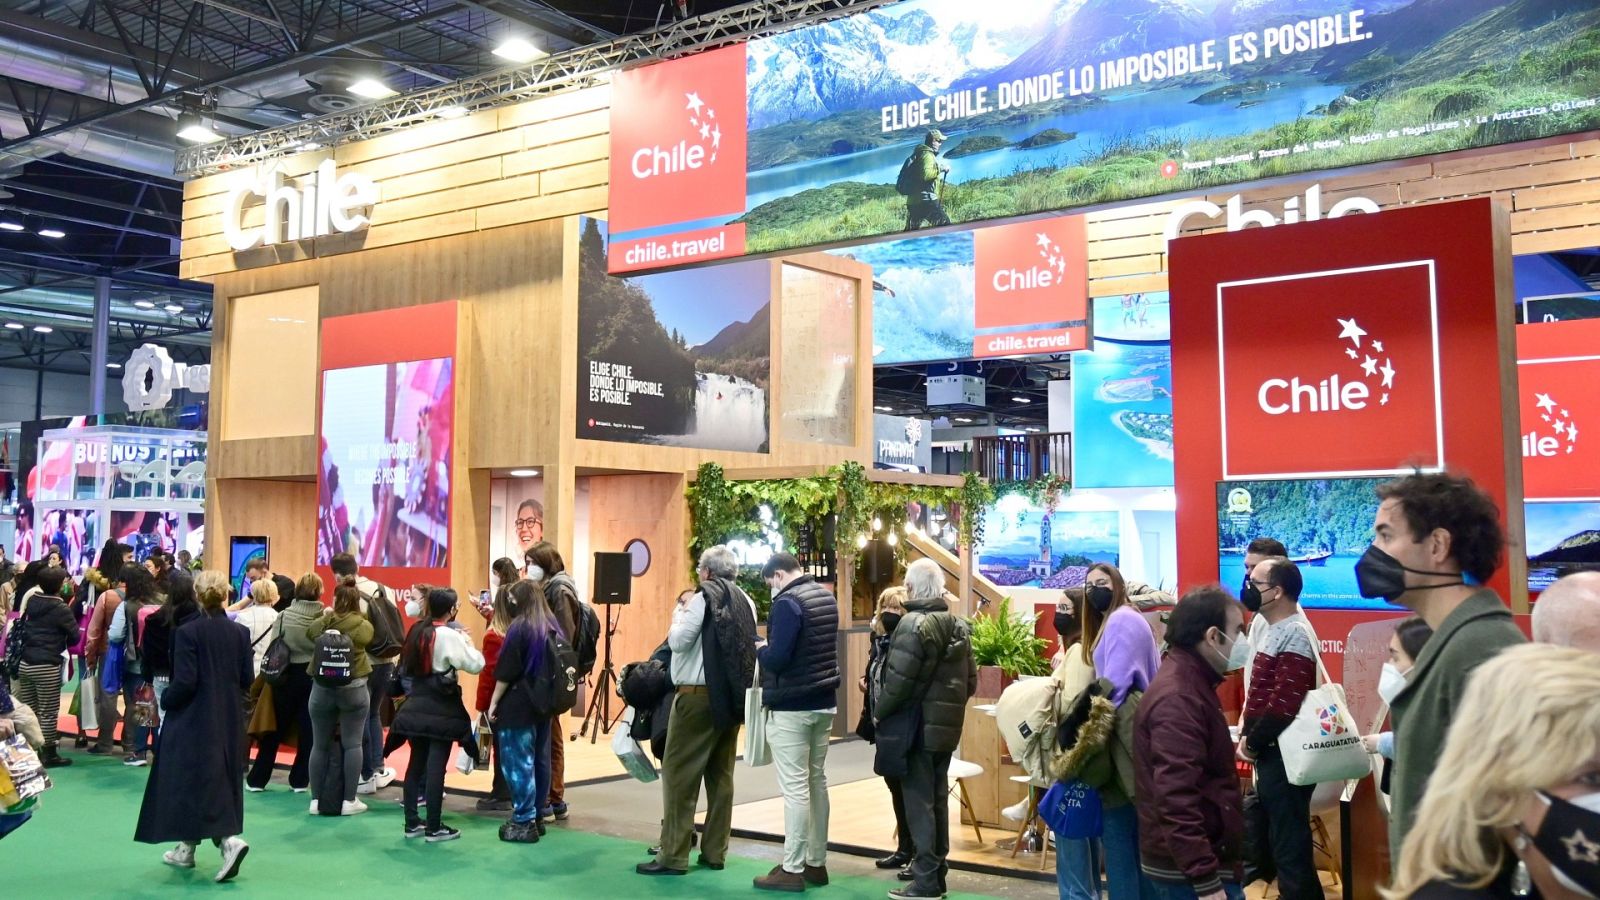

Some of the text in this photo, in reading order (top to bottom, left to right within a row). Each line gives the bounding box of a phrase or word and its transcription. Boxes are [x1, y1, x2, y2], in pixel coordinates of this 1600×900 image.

[881, 9, 1373, 133] ELIGE CHILE. DONDE LO IMPOSIBLE, ES POSIBLE.
[1293, 143, 1308, 153] del
[1350, 133, 1382, 145] Región
[1387, 129, 1399, 138] de
[1403, 120, 1459, 136] Magallanes
[1465, 118, 1471, 128] y
[1476, 115, 1487, 124] la
[1492, 106, 1548, 121] Antártica
[1552, 99, 1596, 112] Chilena
[632, 140, 705, 179] Chile
[223, 158, 377, 251] Chile
[625, 231, 725, 265] chile.travel
[993, 266, 1053, 292] Chile
[988, 332, 1070, 352] chile.travel
[590, 360, 634, 380] ELIGE CHILE.
[589, 388, 632, 406] ES POSIBLE.
[590, 374, 664, 398] DONDE LO IMPOSIBLE,
[1258, 374, 1369, 415] Chile
[1522, 431, 1559, 456] ile
